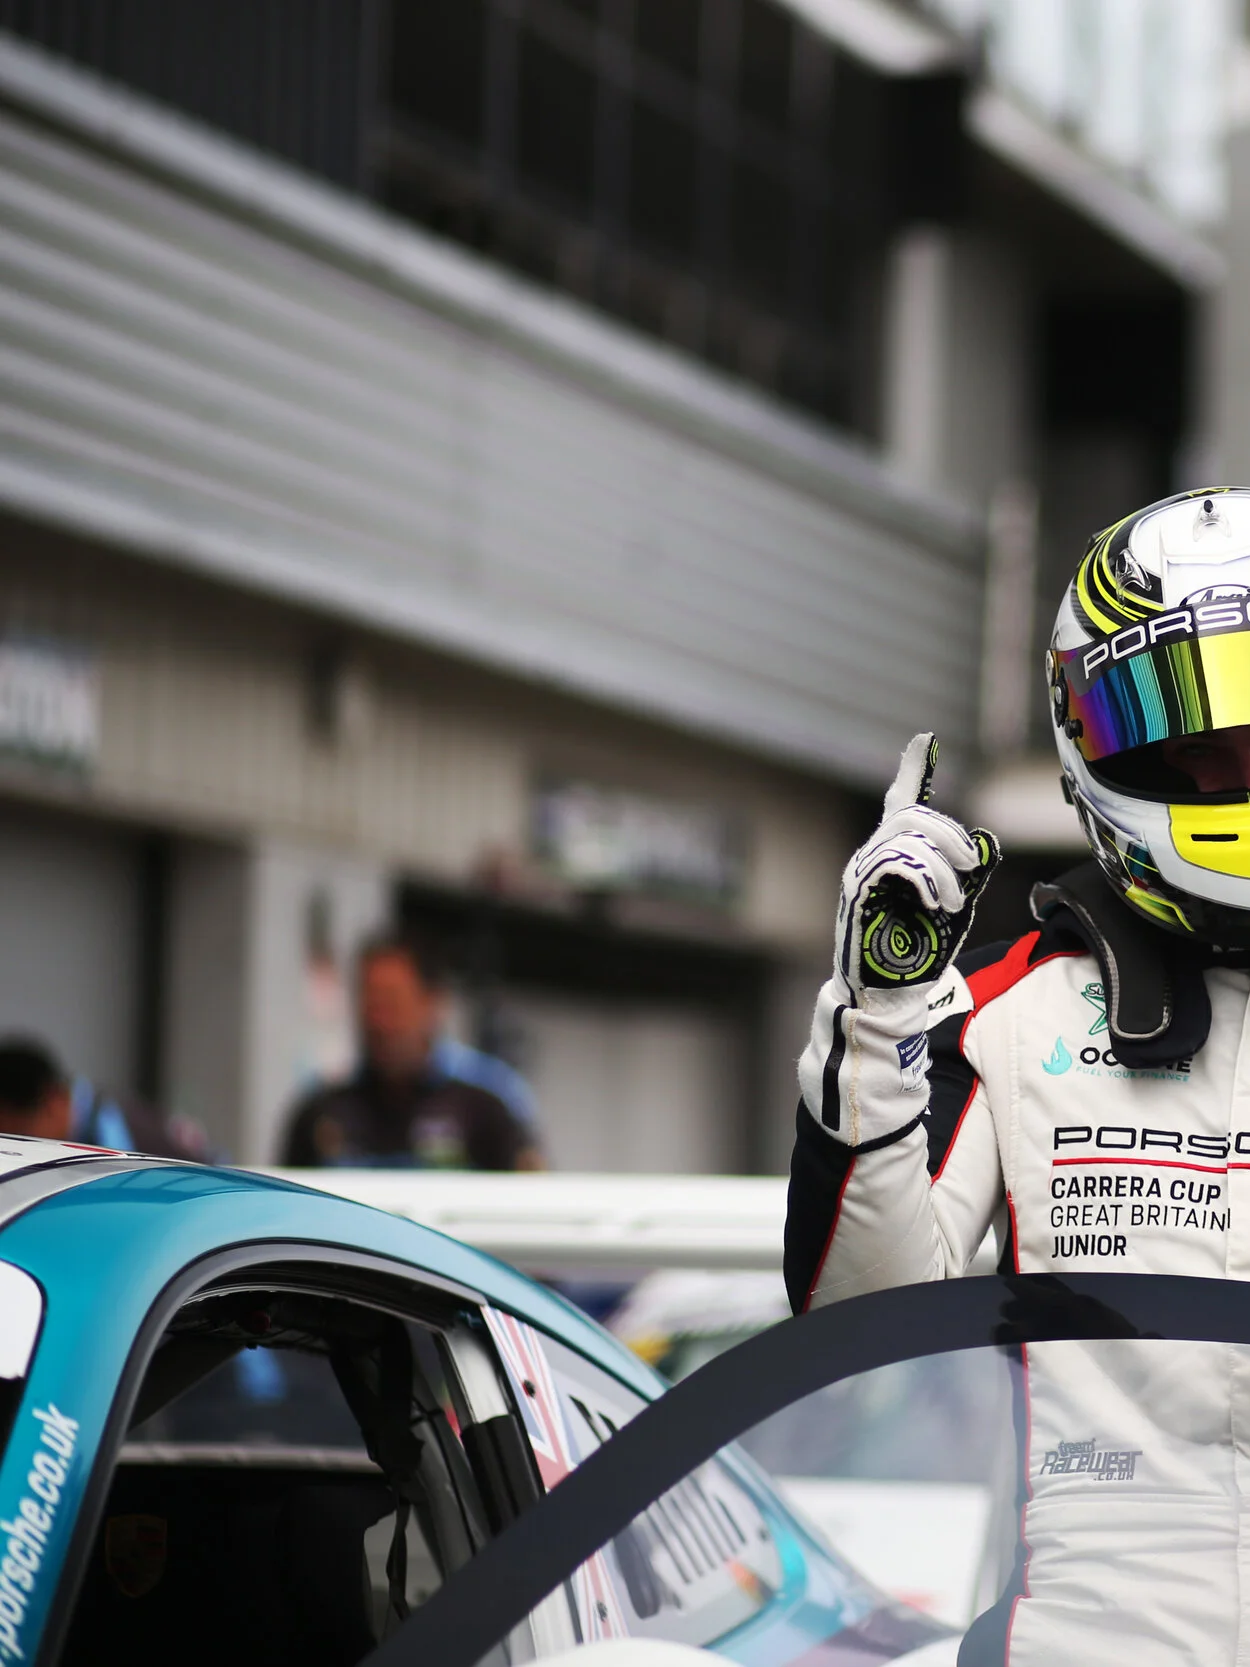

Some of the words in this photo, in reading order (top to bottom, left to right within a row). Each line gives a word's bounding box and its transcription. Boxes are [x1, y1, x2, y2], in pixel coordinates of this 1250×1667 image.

[1080, 1046, 1193, 1073] OCE
[1075, 1066, 1101, 1077] FUEL
[1108, 1069, 1137, 1079] YOUR
[1140, 1070, 1190, 1082] FINANCE
[1051, 1176, 1162, 1199] CARRERA
[1170, 1180, 1222, 1205] CUP
[1050, 1204, 1123, 1228] GREAT
[1131, 1204, 1231, 1232] BRITAIN
[1051, 1234, 1127, 1259] JUNIOR
[0, 1402, 80, 1667] .porsche.co.uk
